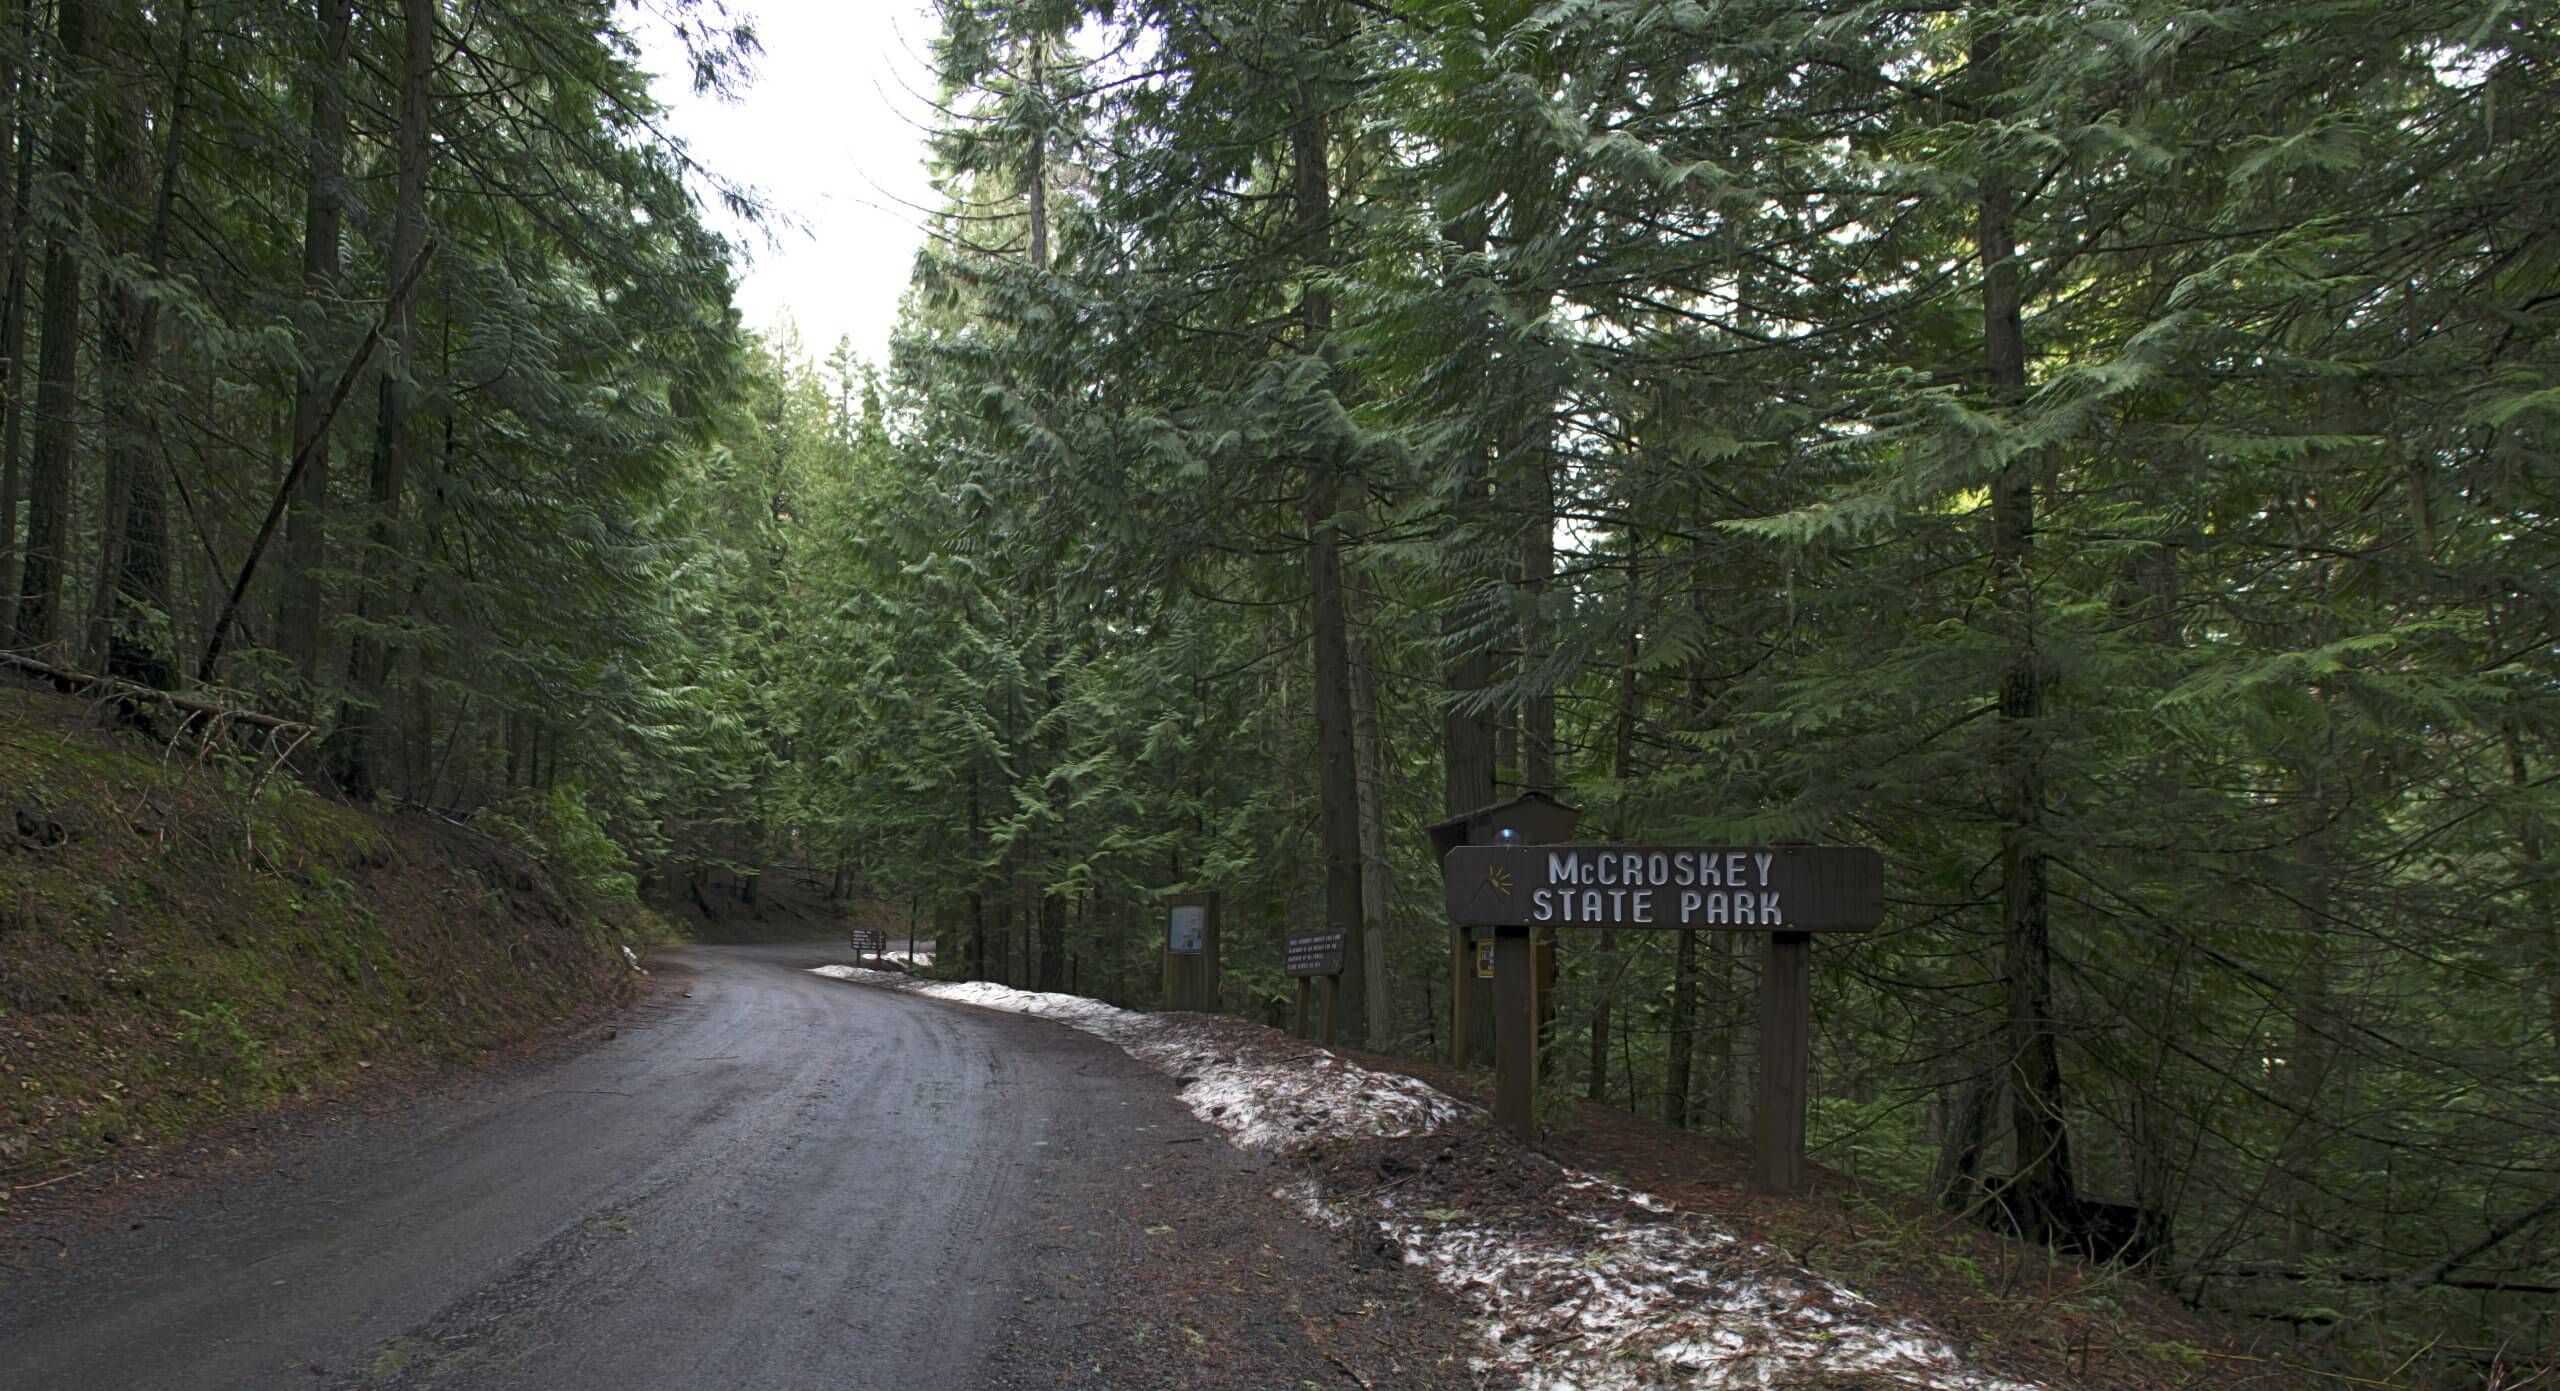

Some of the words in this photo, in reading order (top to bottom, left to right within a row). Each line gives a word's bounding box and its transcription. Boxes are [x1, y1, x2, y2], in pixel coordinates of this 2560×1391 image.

[1549, 851, 1774, 887] McCROSKEY
[1532, 888, 1654, 923] STATE
[1681, 890, 1783, 925] PARK
